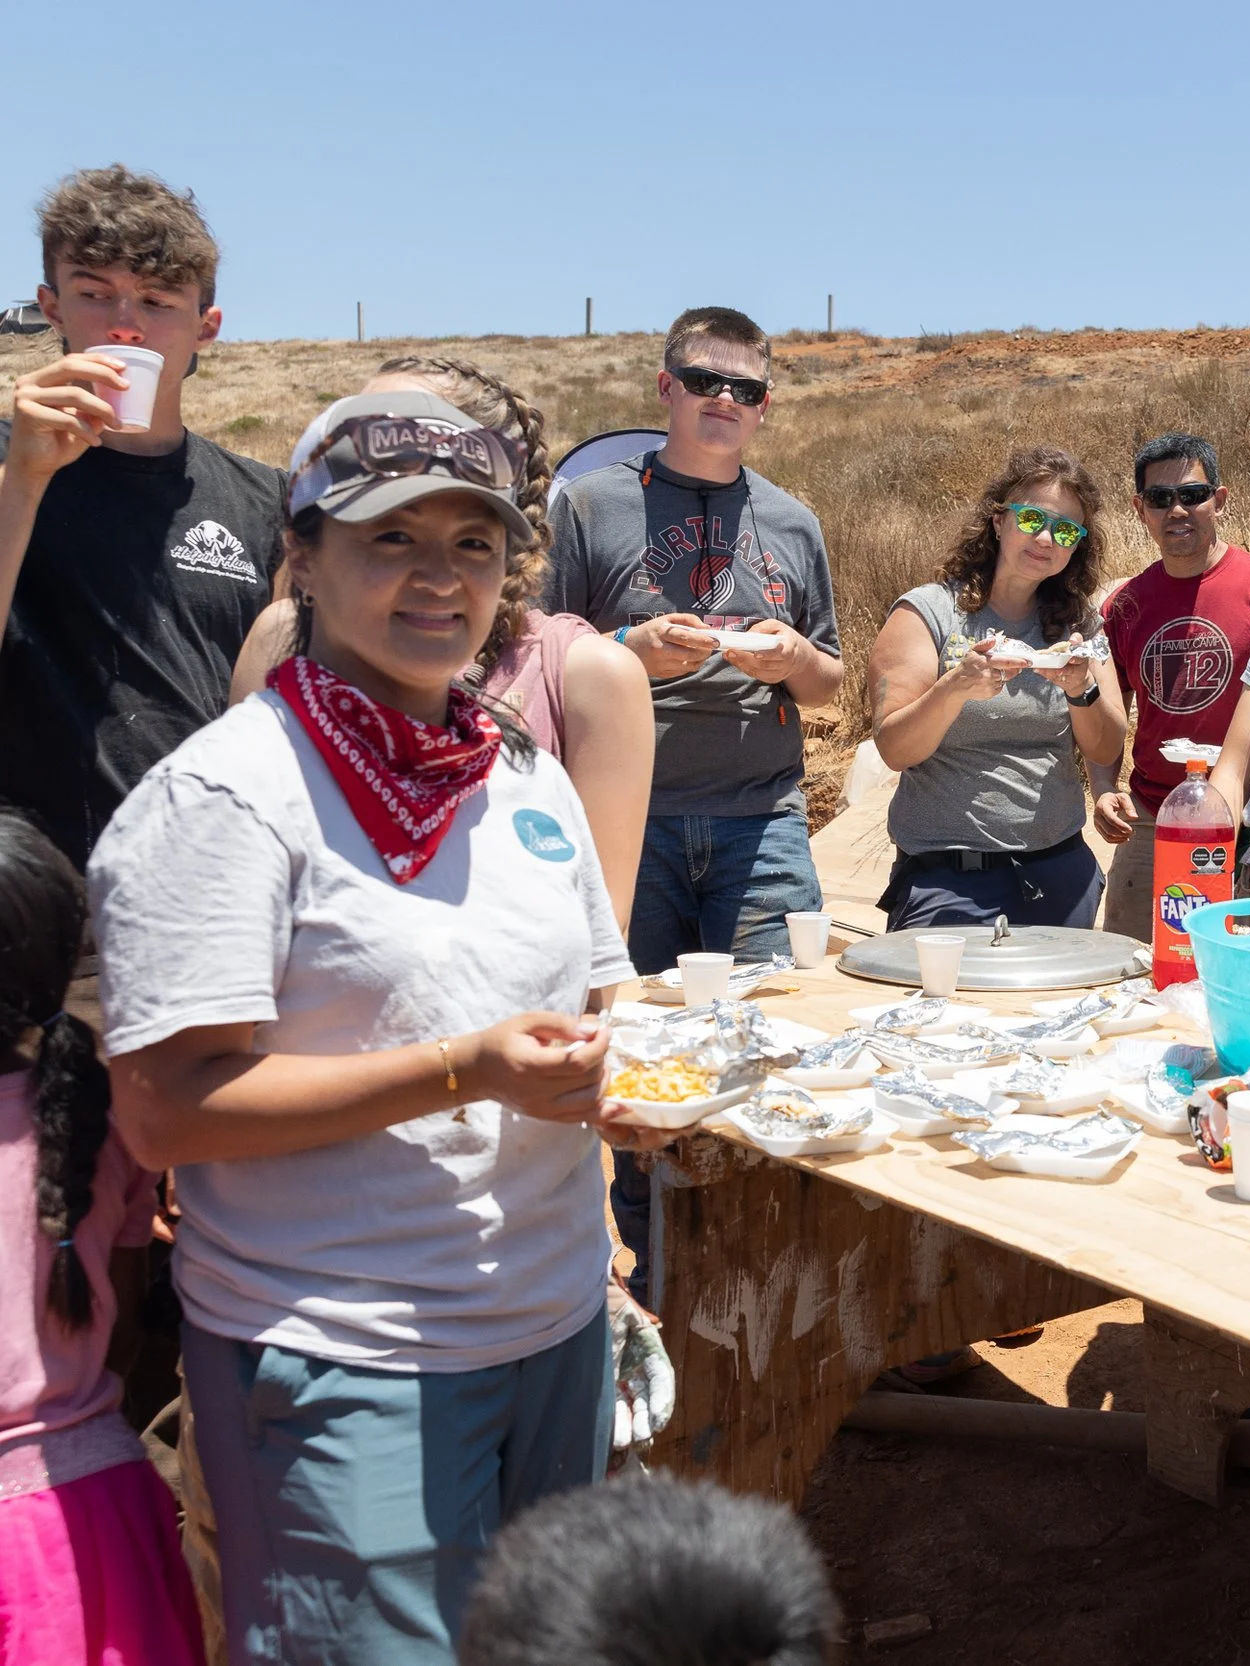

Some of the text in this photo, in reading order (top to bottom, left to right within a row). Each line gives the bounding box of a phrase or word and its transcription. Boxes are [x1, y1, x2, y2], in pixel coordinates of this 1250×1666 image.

[170, 545, 221, 568] Helping
[629, 515, 787, 605] PORTLAND
[1161, 636, 1221, 651] FAMILY CAMP
[1184, 650, 1222, 690] 12
[1160, 895, 1210, 920] FANT
